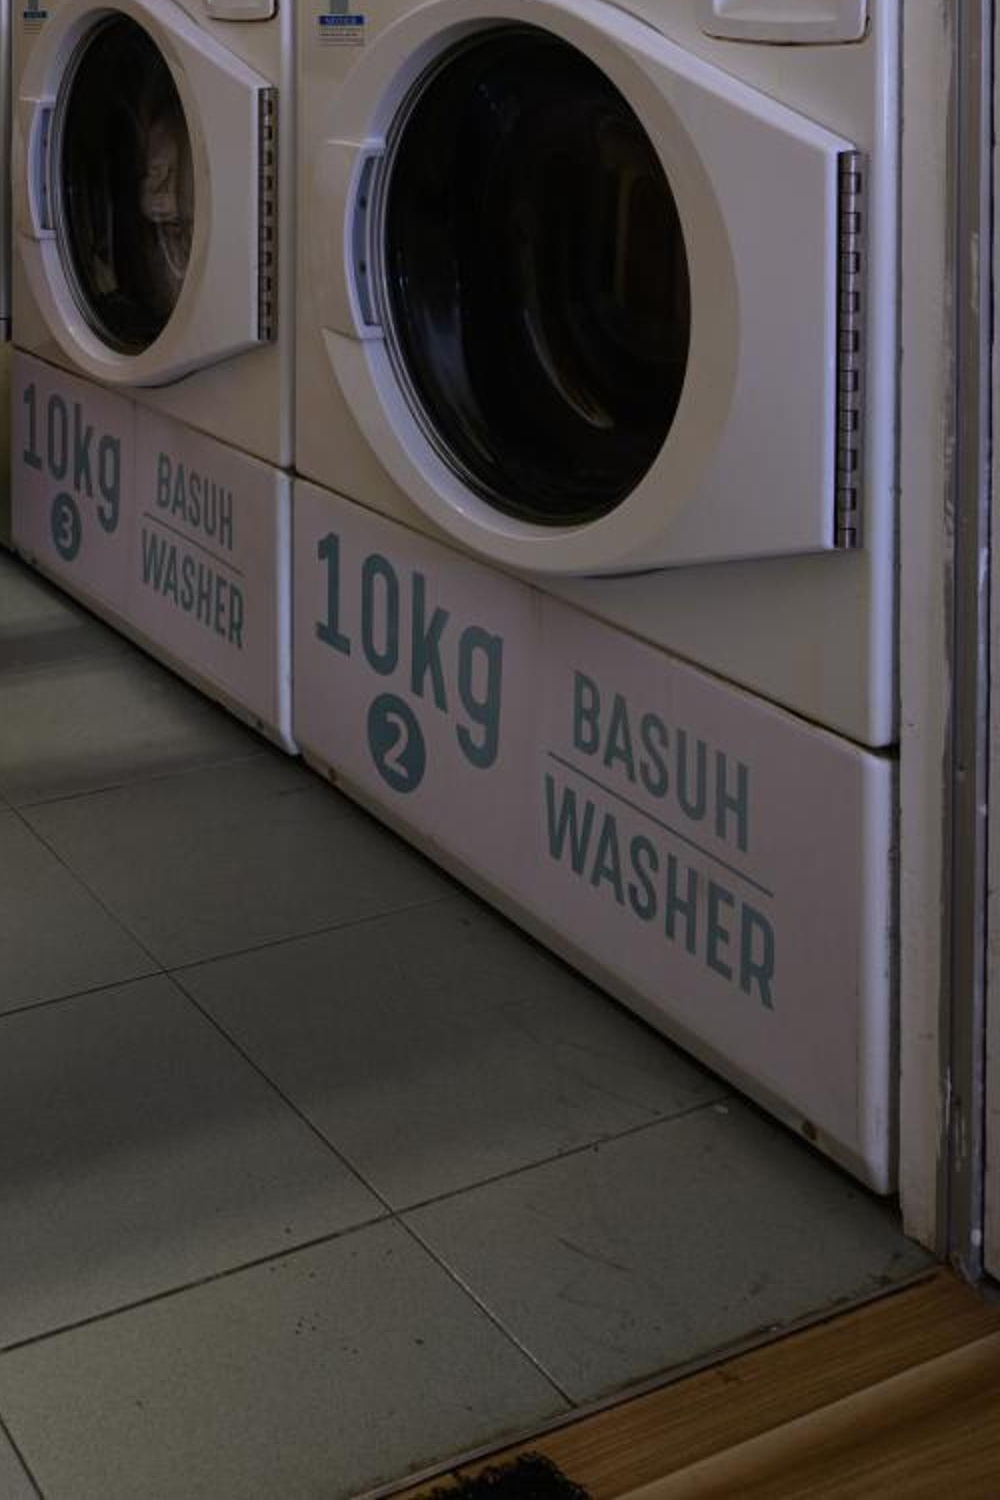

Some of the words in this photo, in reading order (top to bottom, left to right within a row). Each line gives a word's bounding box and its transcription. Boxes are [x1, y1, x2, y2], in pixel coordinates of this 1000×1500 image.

[23, 383, 121, 533] 10kg
[158, 452, 232, 550] BASUH
[142, 528, 243, 649] WASHER
[316, 532, 504, 769] 10kg
[573, 670, 749, 853] BASUH
[545, 772, 775, 1011] WASHER
